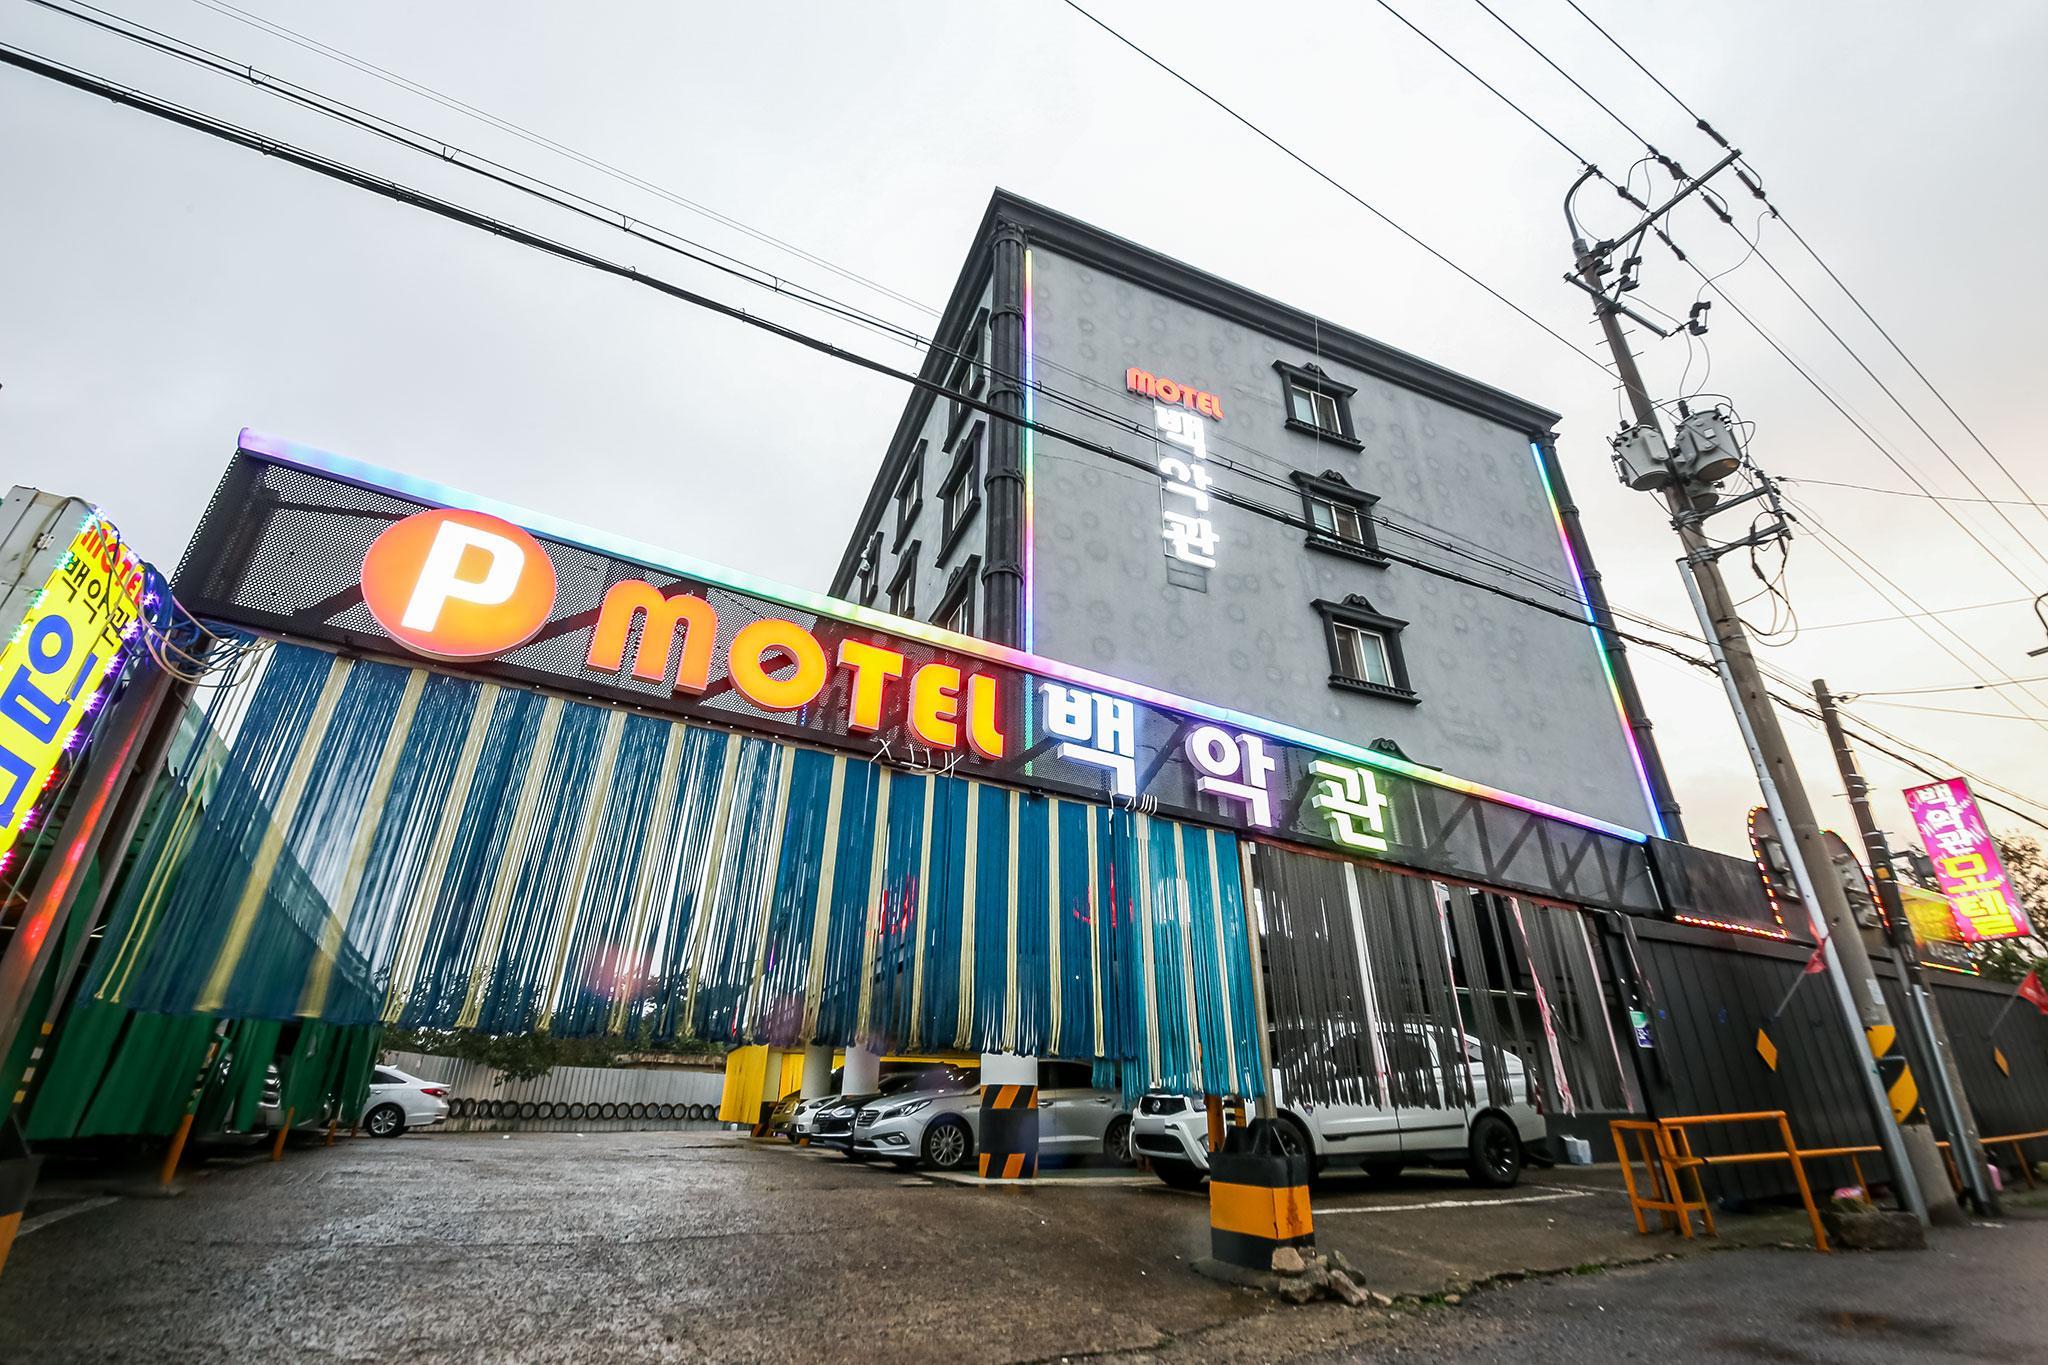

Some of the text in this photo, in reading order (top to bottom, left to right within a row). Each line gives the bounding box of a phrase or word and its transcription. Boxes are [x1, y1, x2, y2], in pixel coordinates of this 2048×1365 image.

[1126, 367, 1224, 421] MOTEL
[1155, 407, 1220, 569] 백악관
[401, 519, 1004, 761] P MOTEL
